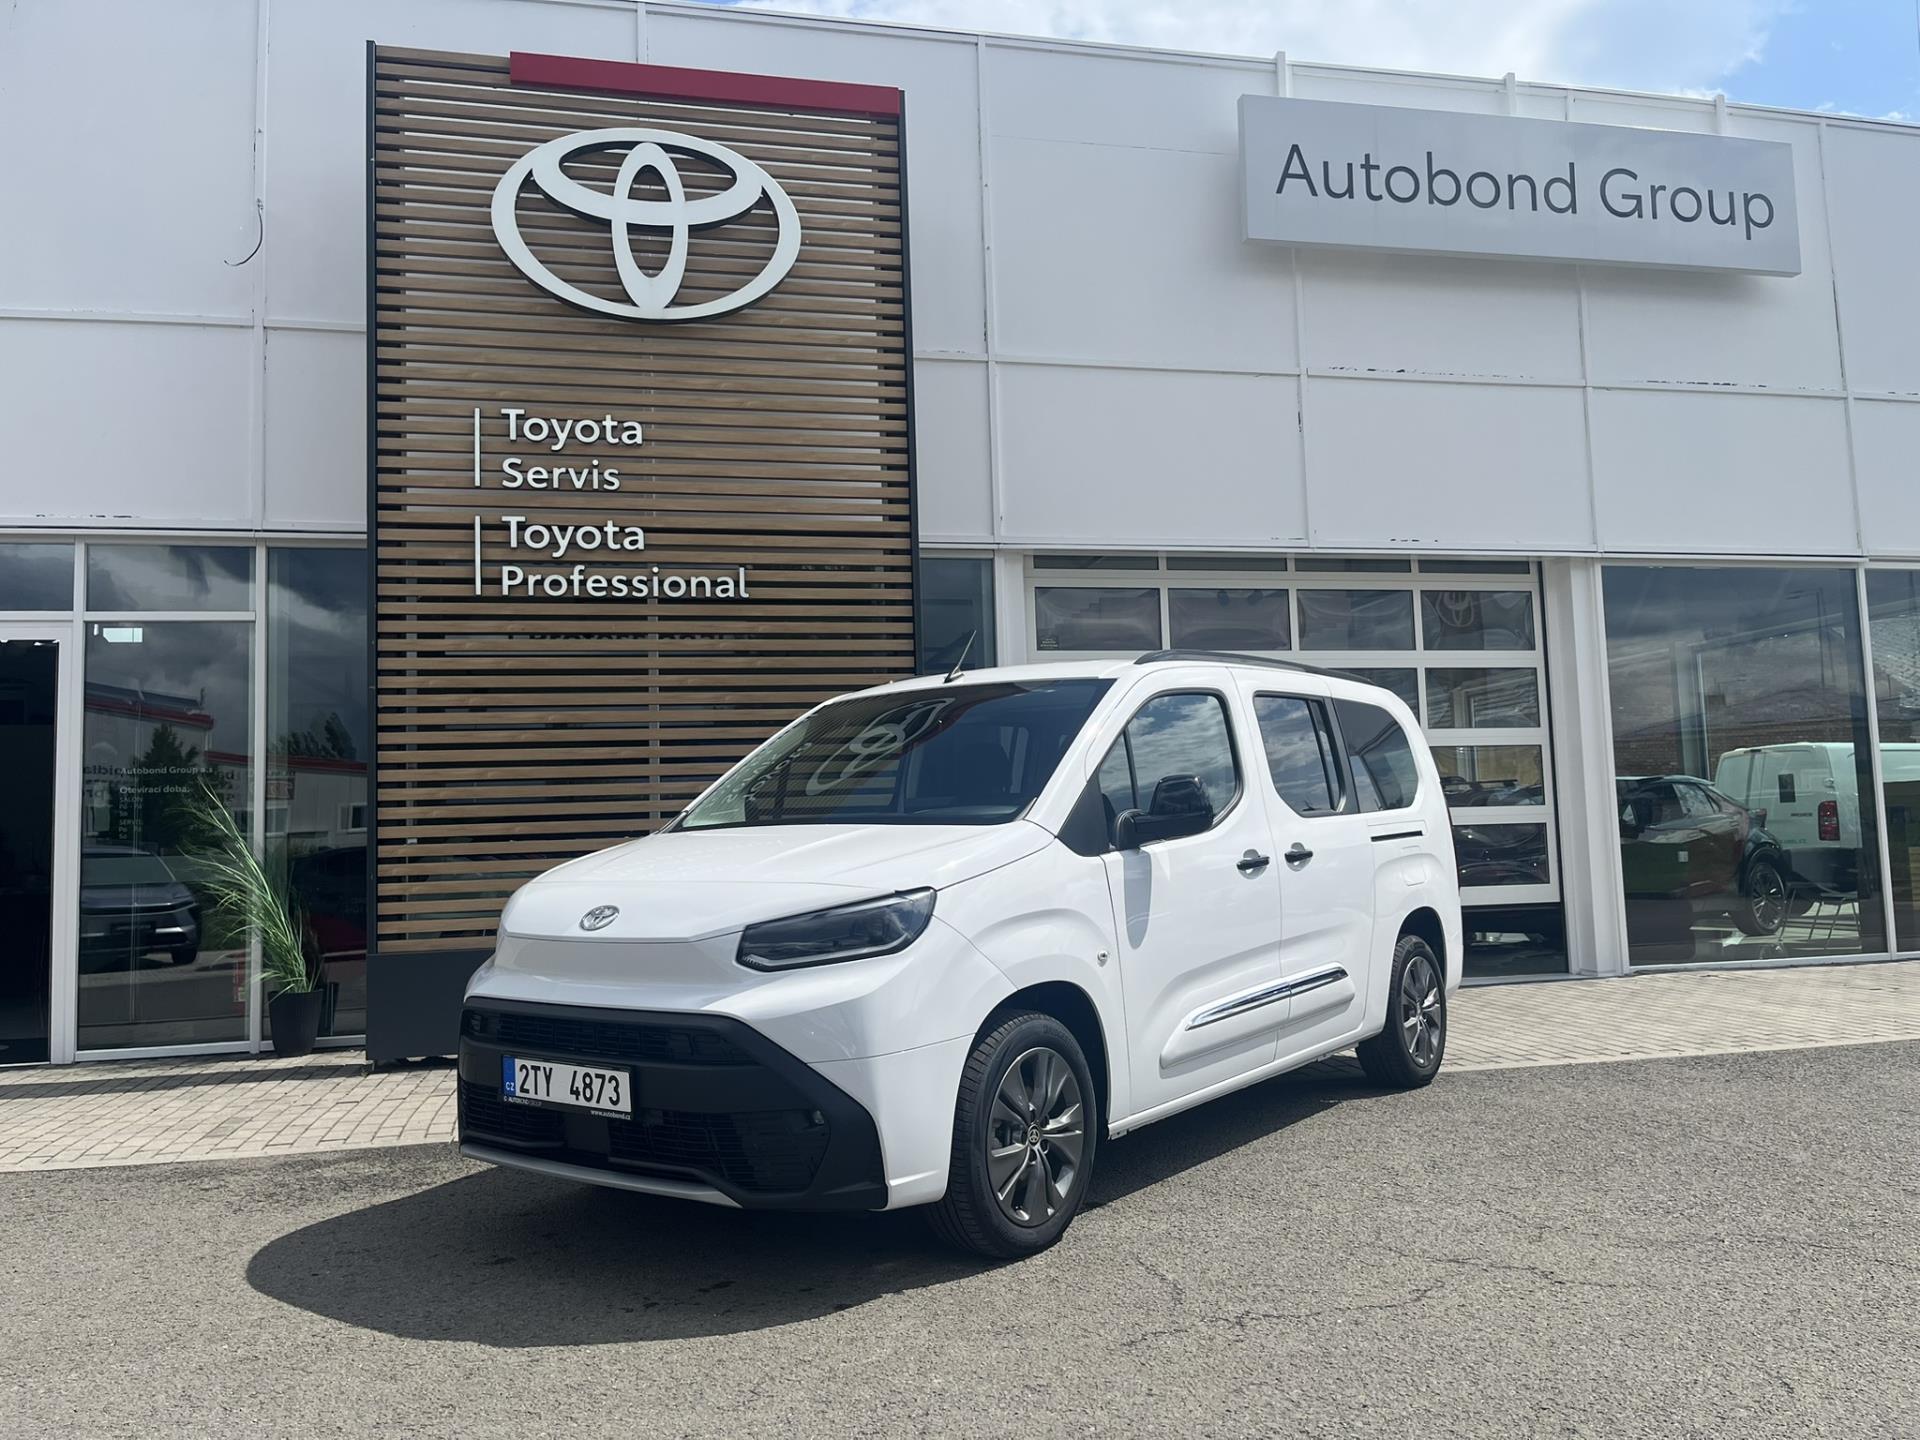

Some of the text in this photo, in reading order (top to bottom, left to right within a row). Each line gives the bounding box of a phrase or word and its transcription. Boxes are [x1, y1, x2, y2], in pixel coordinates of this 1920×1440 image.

[1275, 143, 1775, 240] Autobond Group
[501, 408, 643, 451] Toyota
[502, 458, 621, 490] Servis
[501, 516, 645, 558] Toyota
[501, 565, 750, 598] Professional
[120, 766, 167, 775] Autobond
[505, 1064, 621, 1106] CZ 2TY 4873
